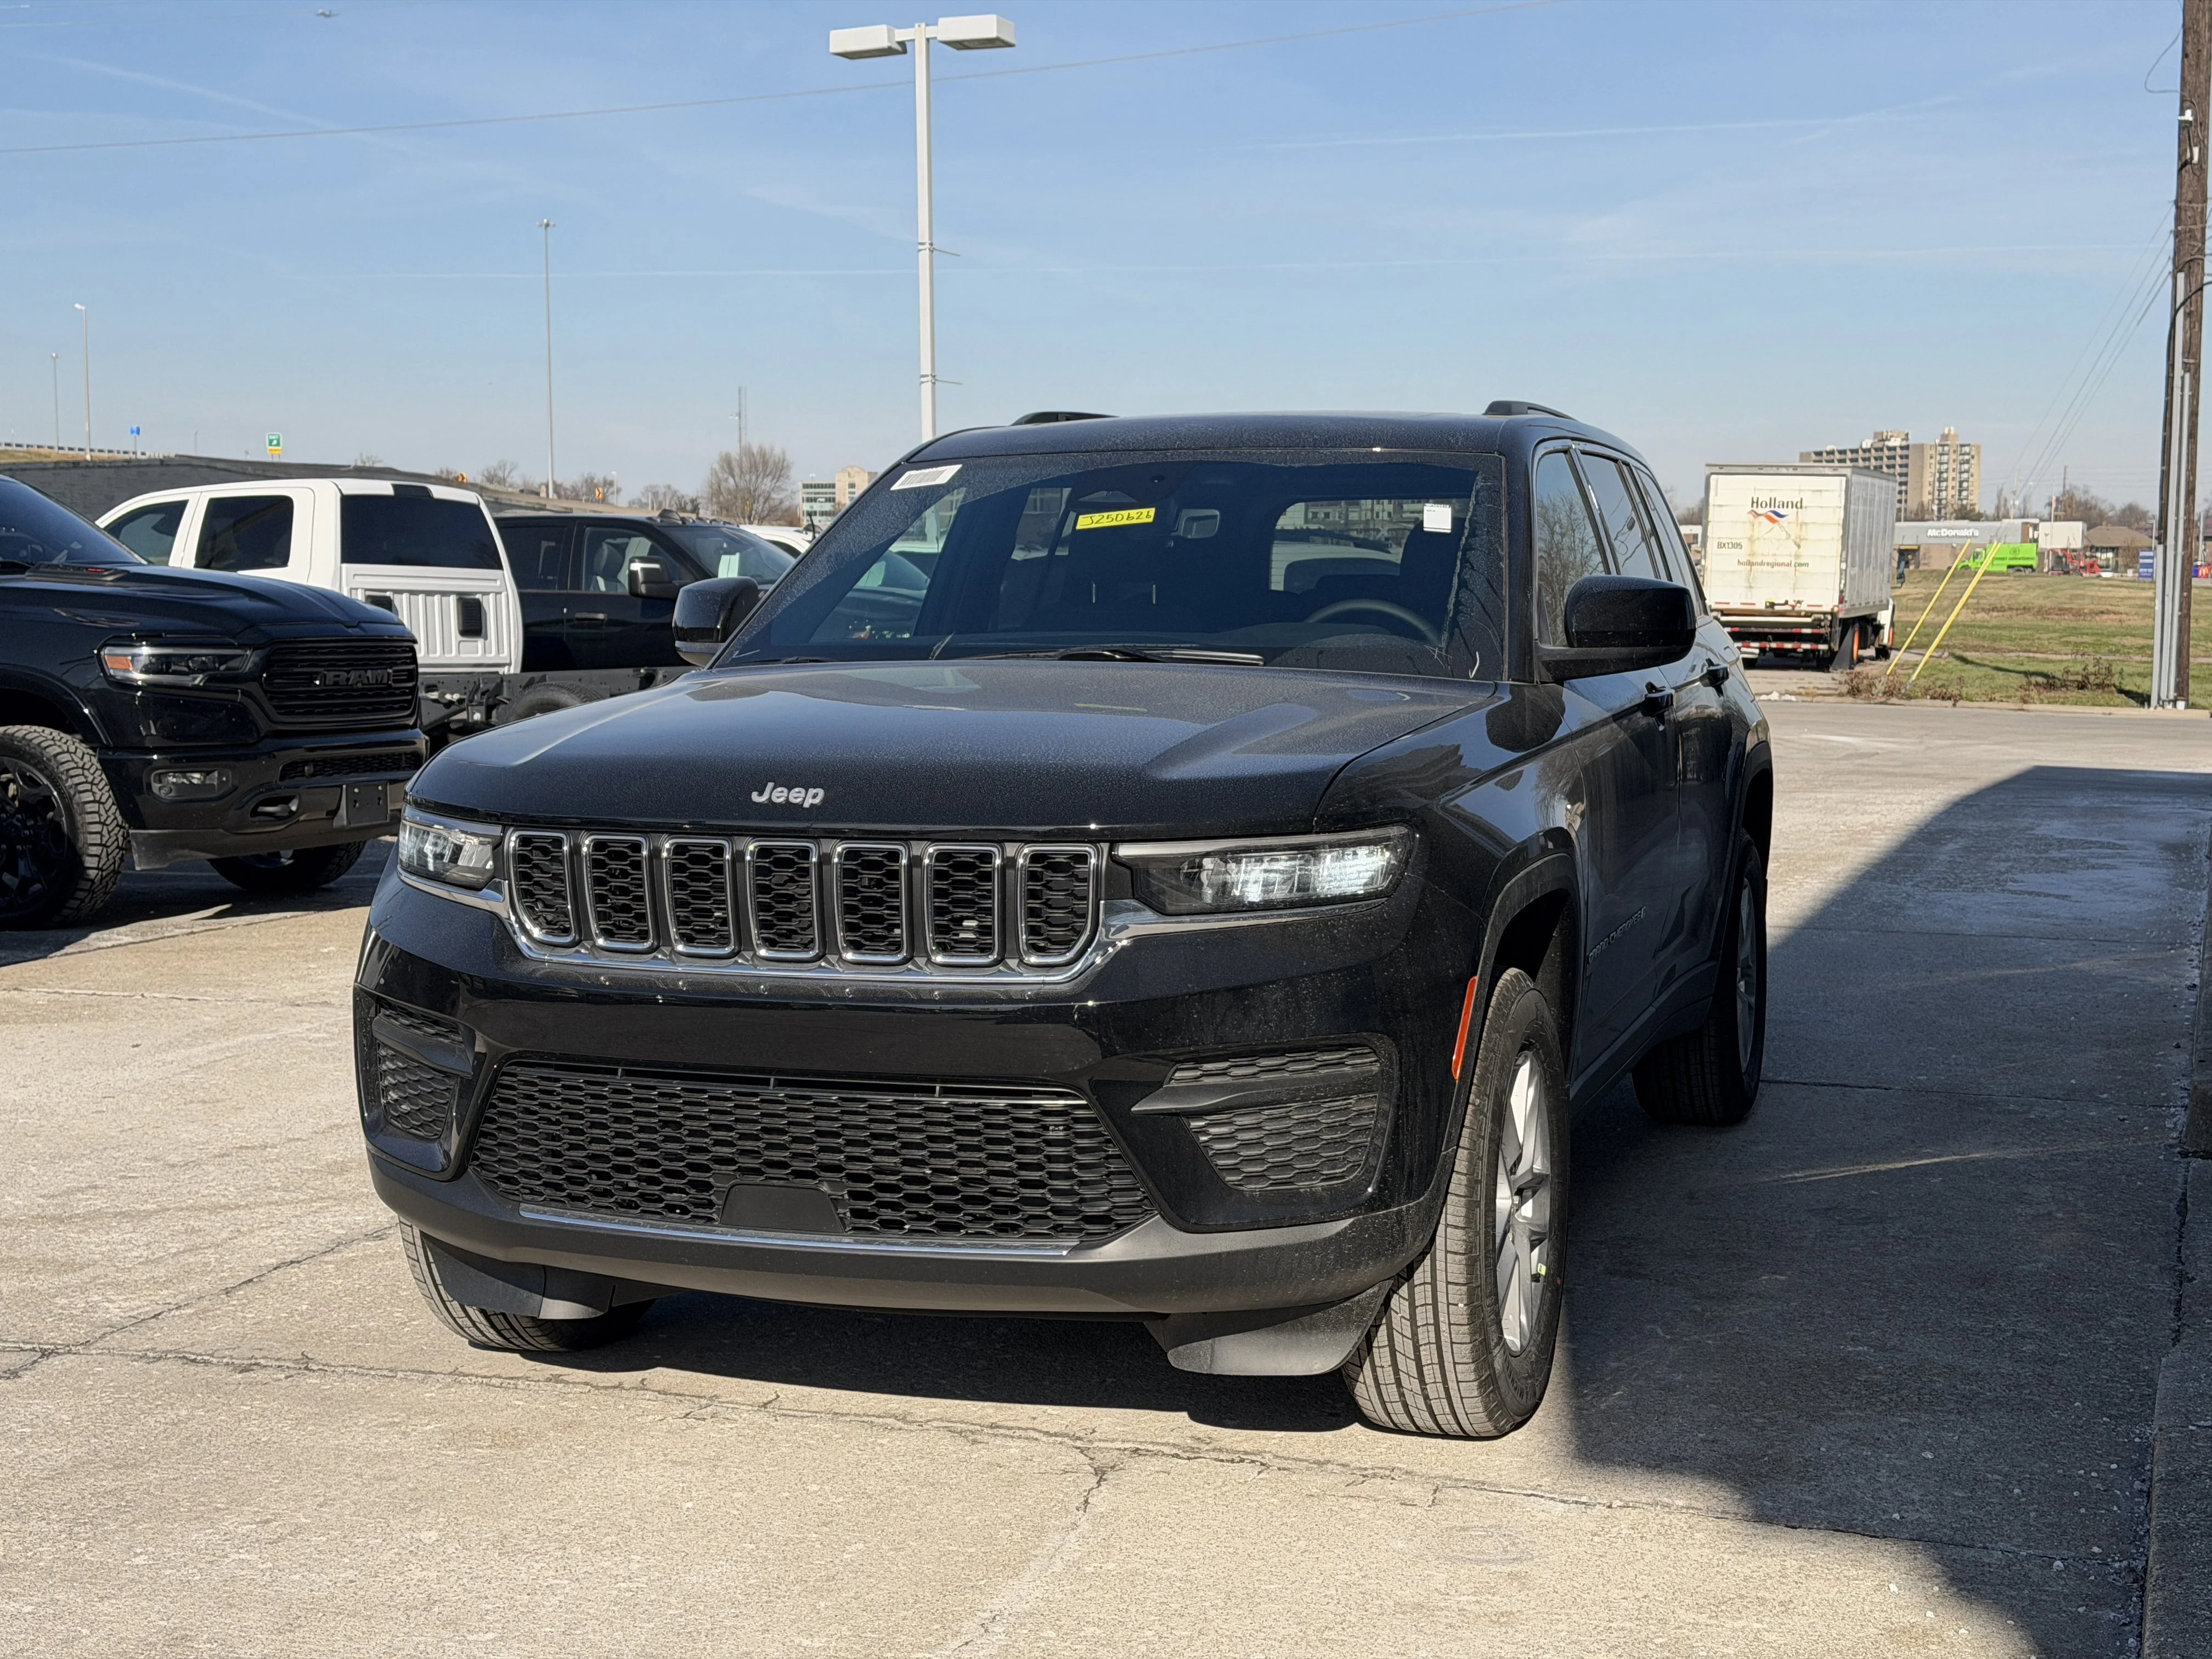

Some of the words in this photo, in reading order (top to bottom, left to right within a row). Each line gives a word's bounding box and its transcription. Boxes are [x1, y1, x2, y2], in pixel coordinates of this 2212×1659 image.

[1751, 496, 1803, 510] Holland
[1927, 528, 1979, 537] McDonald's
[325, 669, 388, 685] RAM
[751, 782, 825, 808] Jeep
